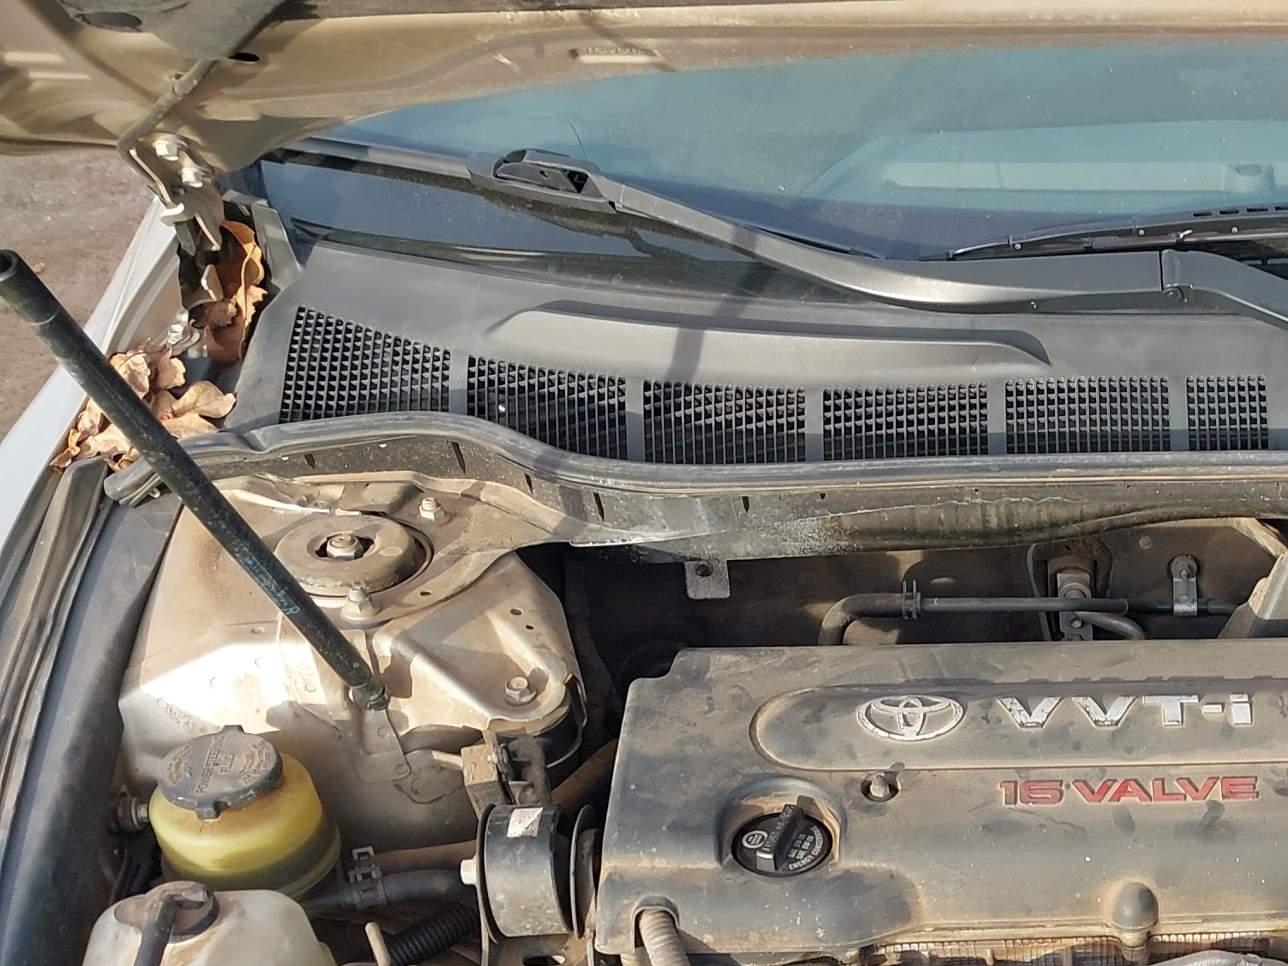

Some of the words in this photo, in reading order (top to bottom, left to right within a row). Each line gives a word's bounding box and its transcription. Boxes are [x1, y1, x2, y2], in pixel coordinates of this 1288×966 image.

[998, 693, 1253, 728] VVT-i
[1000, 779, 1061, 806] 16
[1071, 776, 1260, 804] VALVE
